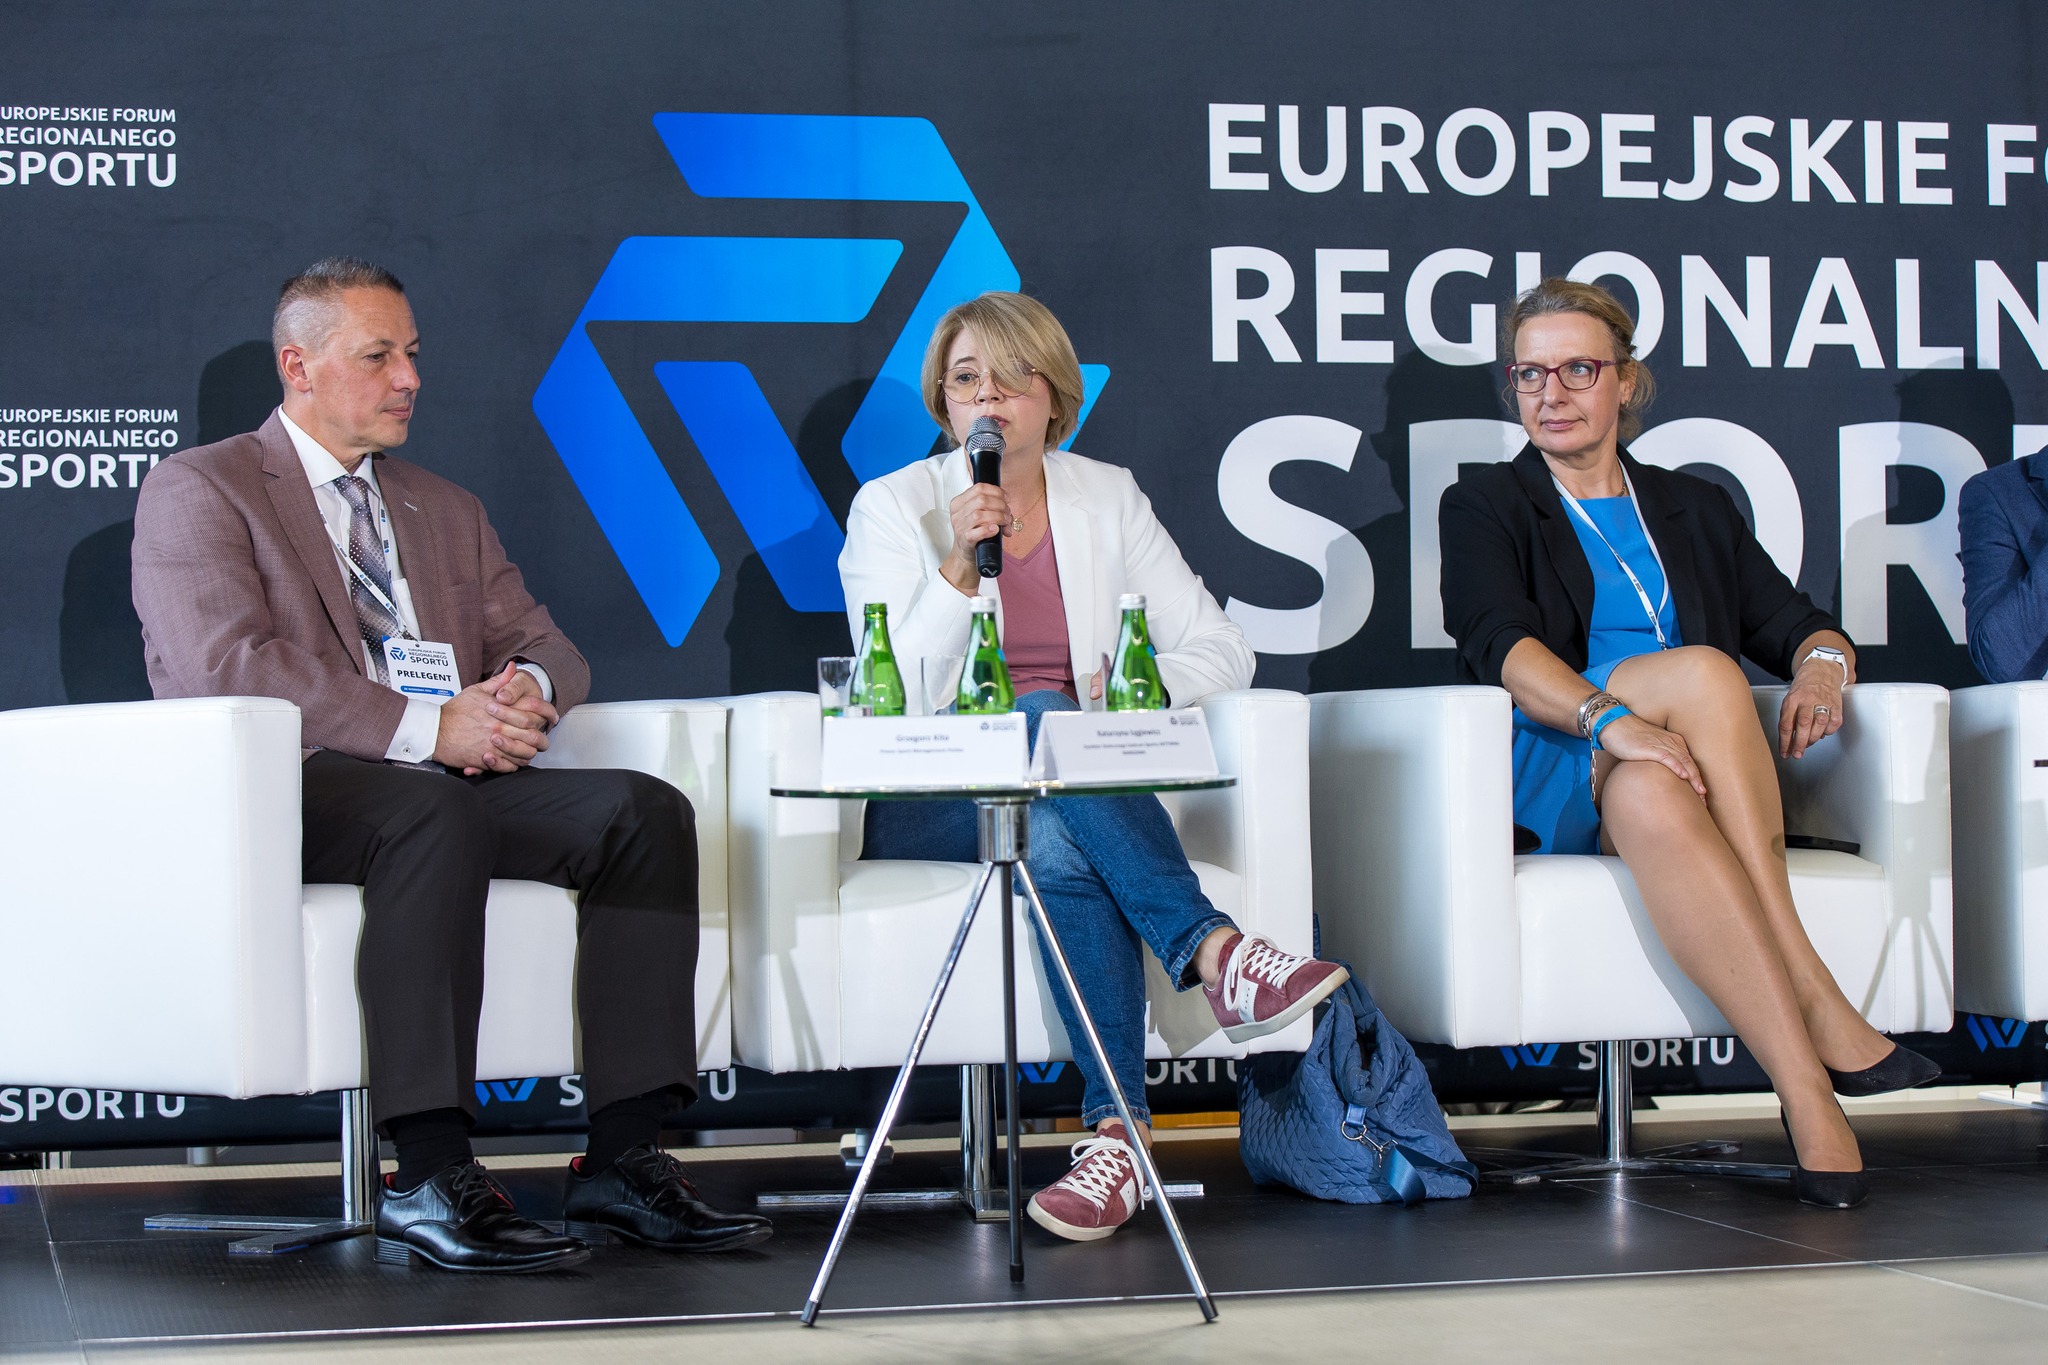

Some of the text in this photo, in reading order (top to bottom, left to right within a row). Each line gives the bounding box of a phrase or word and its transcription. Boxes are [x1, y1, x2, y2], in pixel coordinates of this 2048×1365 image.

[113, 108, 176, 122] FORUM
[0, 127, 176, 147] EGIONALNEGO
[1208, 103, 2048, 206] EUROPEJSKIE F
[0, 408, 178, 423] UROPEJSKIE FORUM
[0, 453, 175, 489] SPORT
[410, 656, 449, 667] SPORTU
[397, 669, 452, 682] PRELEGENT
[1578, 1037, 1735, 1071] SORTU
